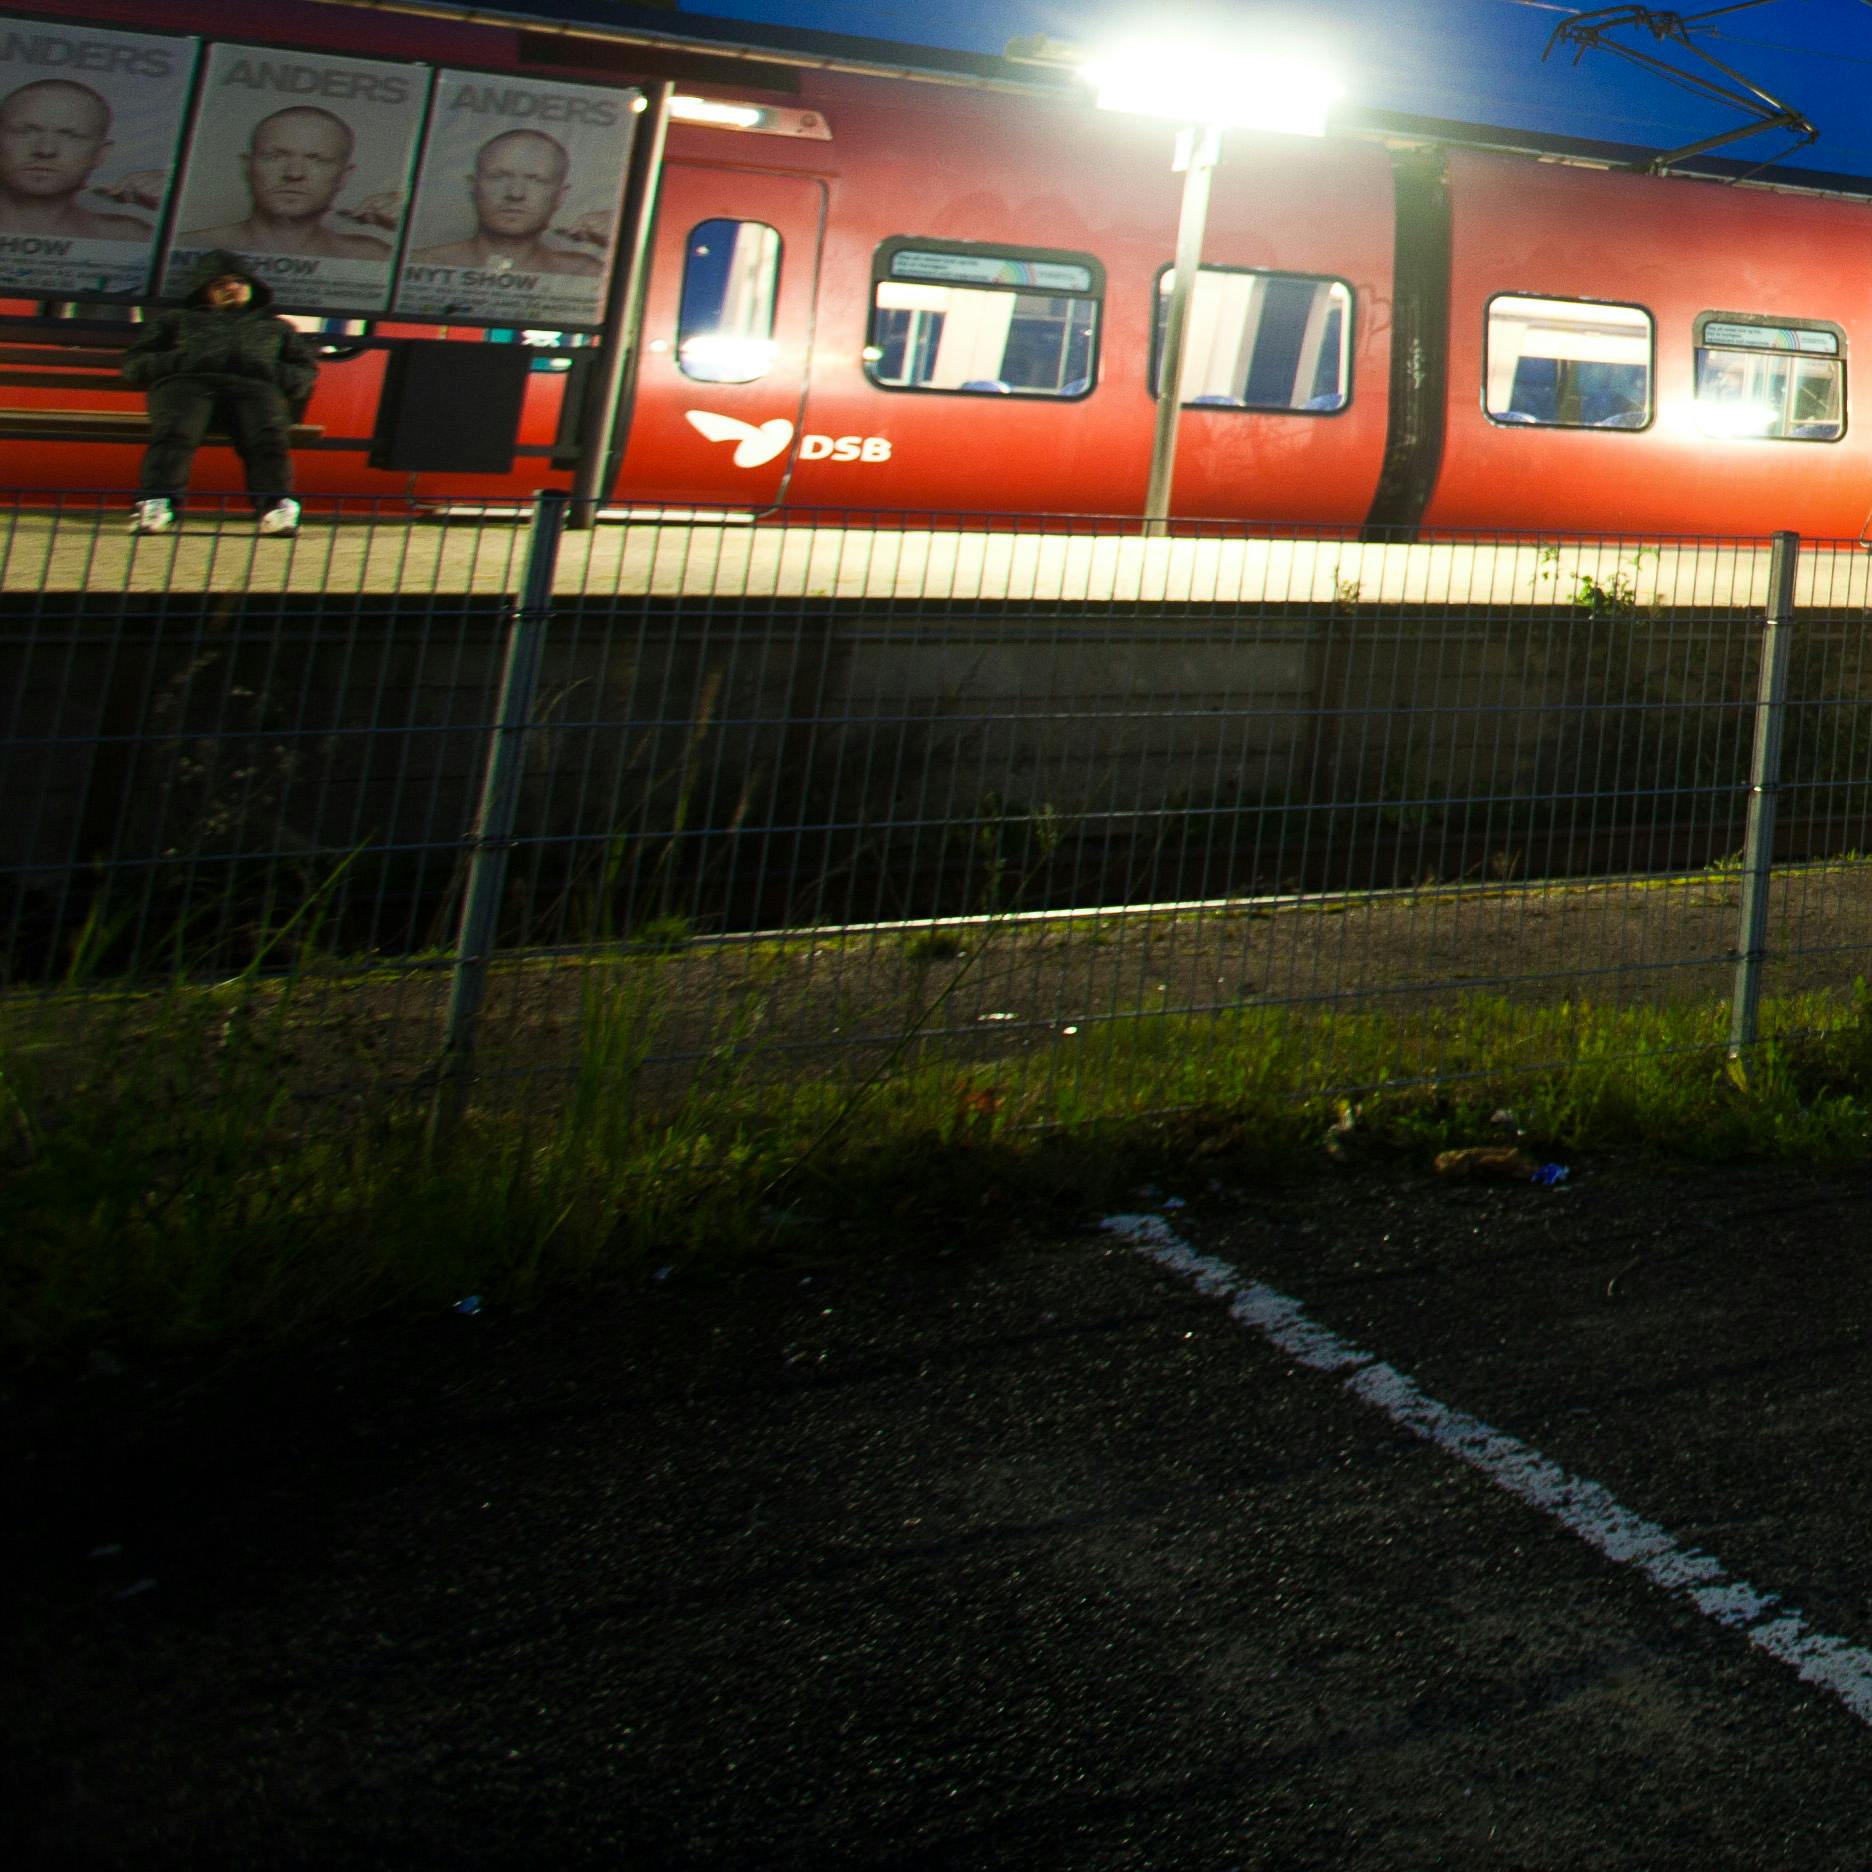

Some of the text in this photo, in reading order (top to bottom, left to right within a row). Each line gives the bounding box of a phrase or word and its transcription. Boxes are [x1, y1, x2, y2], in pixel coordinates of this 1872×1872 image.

[0, 32, 170, 77] NDERS
[223, 60, 409, 104] ANDERS
[450, 85, 619, 126] ANDERS
[0, 236, 73, 256] HOW
[406, 266, 539, 291] NYT SHOW
[799, 434, 892, 462] DSB
